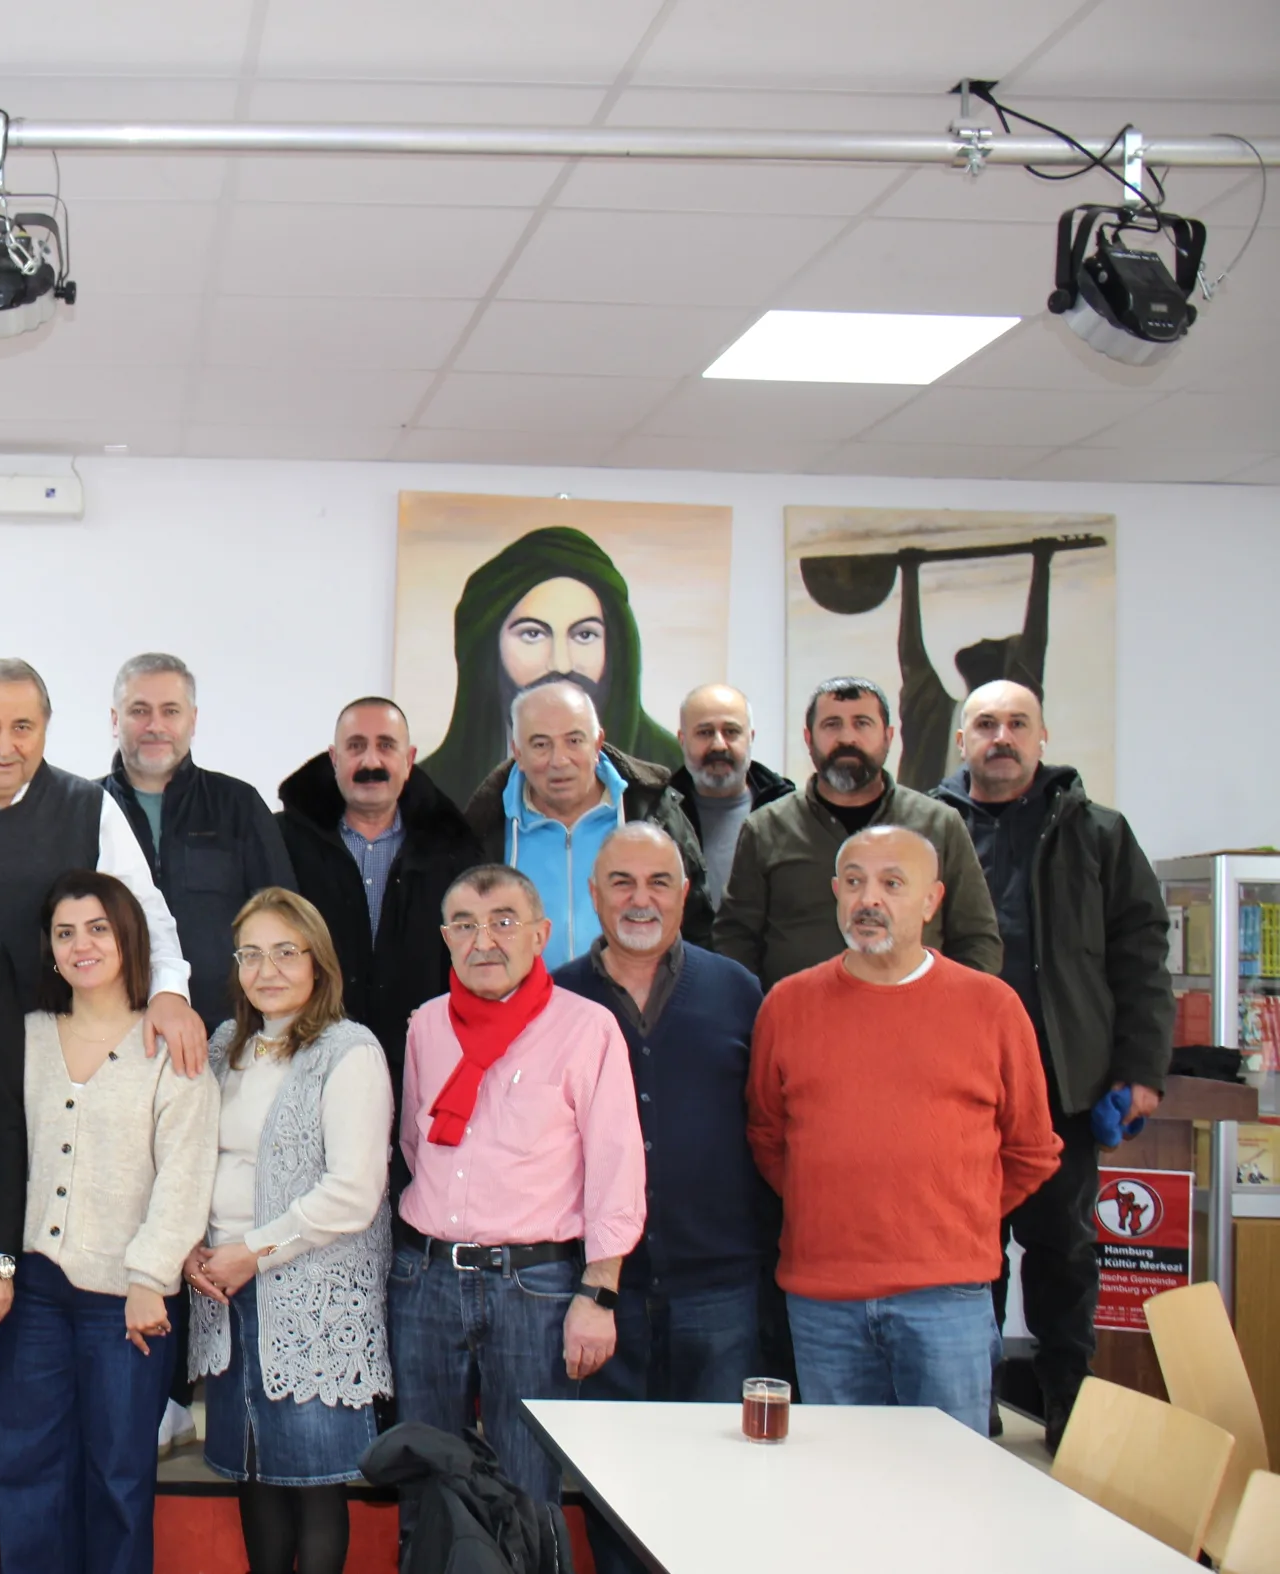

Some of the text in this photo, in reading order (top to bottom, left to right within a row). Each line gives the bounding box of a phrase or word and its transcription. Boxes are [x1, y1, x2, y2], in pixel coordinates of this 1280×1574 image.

[1104, 1244, 1154, 1259] Hamburg
[1104, 1257, 1137, 1269] Kültür
[1130, 1274, 1177, 1286] Gemeinde
[1099, 1284, 1140, 1296] Hamburg
